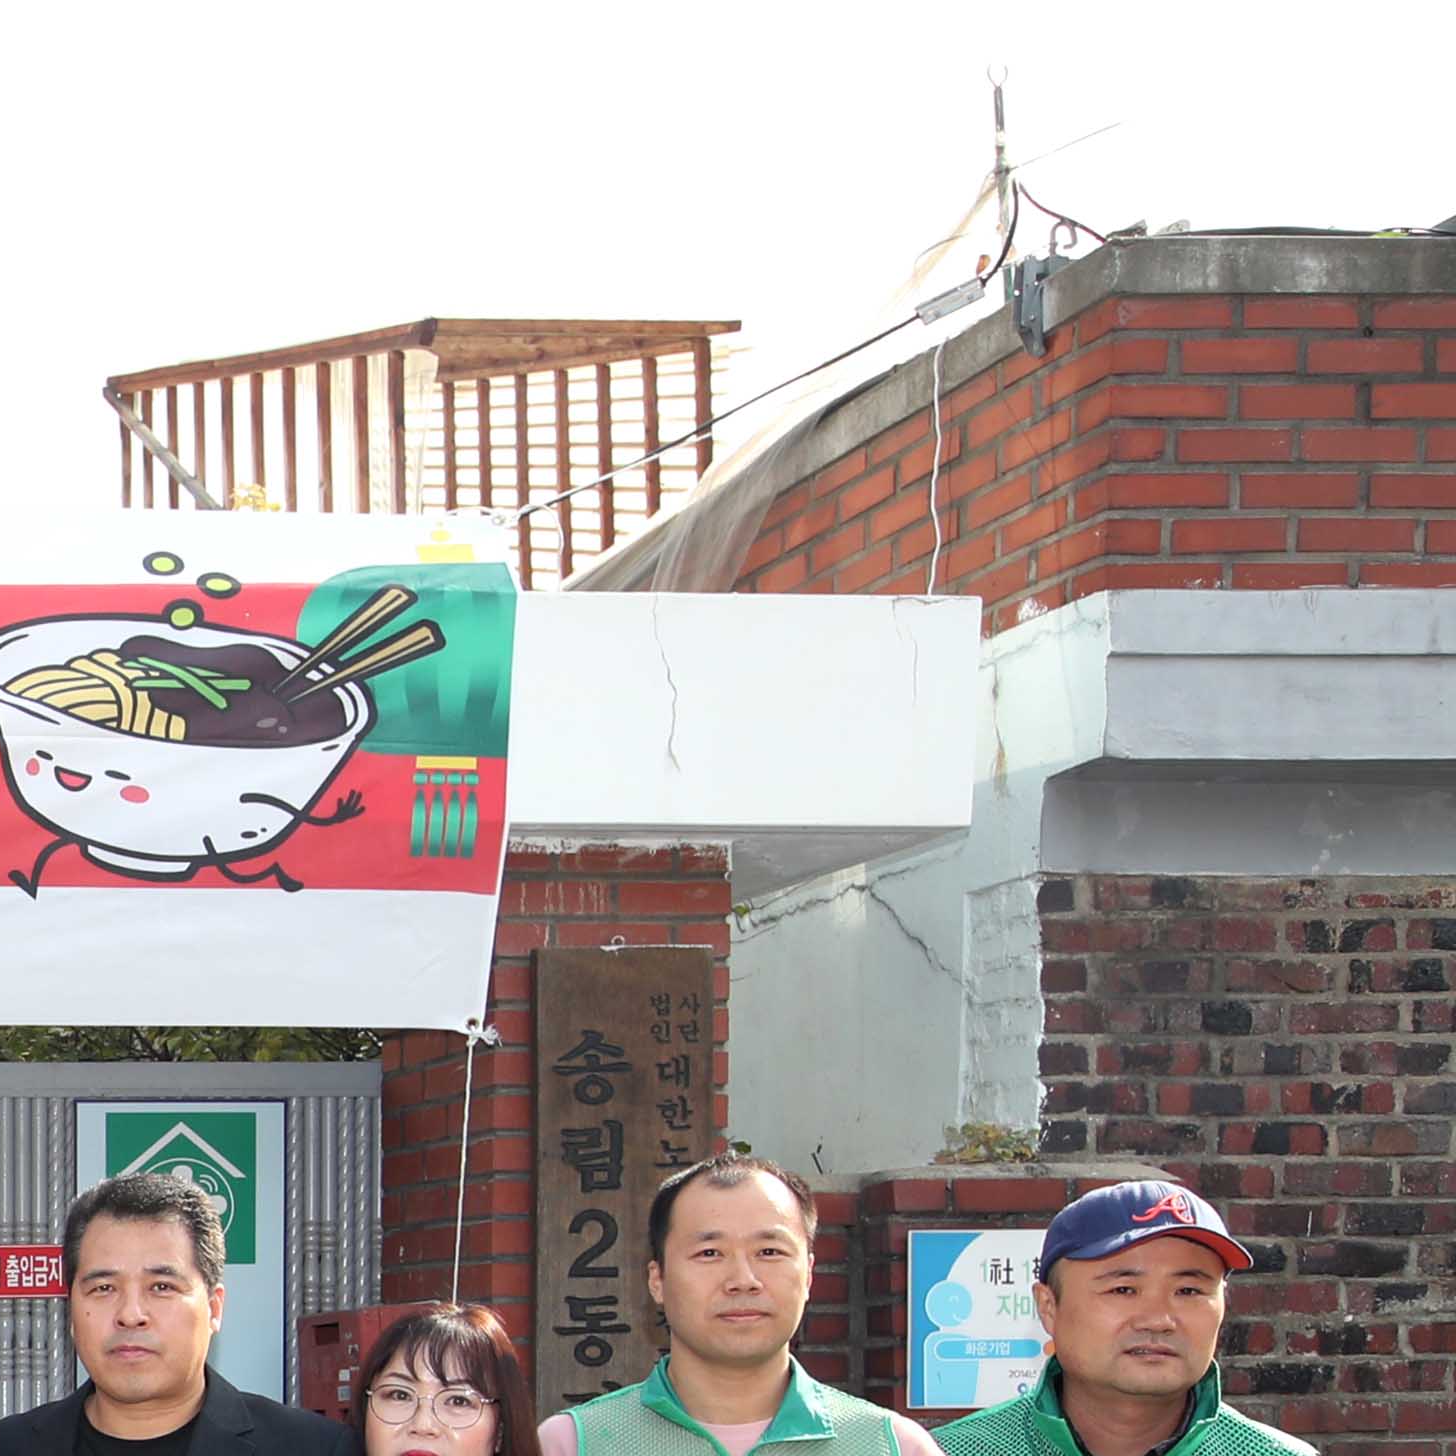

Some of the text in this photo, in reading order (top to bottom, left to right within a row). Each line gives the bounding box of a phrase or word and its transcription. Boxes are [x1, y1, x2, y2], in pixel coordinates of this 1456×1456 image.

[654, 1054, 694, 1168] 대한노
[5, 1254, 63, 1289] 출입금지
[552, 1029, 633, 1402] 송림2동
